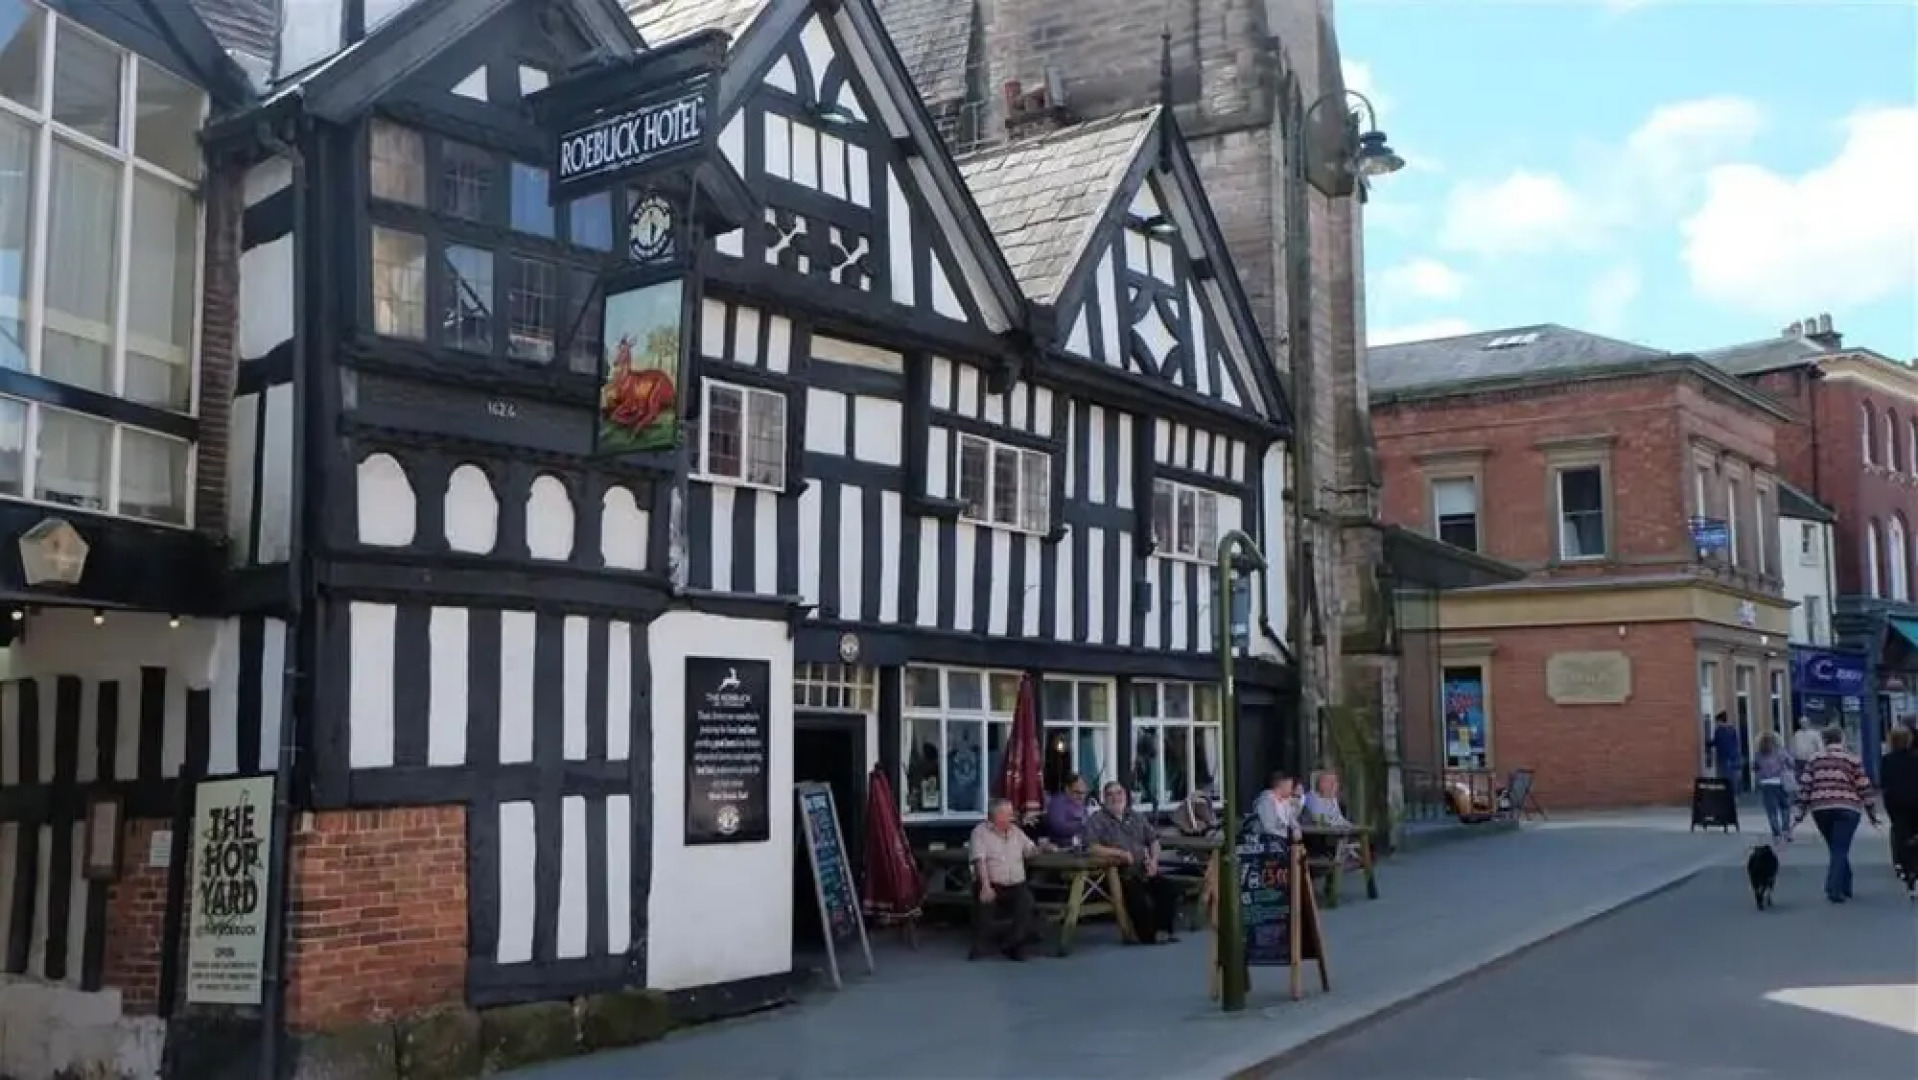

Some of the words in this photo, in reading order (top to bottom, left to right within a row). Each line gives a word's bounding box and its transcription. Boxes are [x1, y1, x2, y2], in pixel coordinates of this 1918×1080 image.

[561, 117, 641, 177] ROEBUCK
[643, 100, 701, 151] HOTEL
[209, 805, 255, 841] THE
[204, 842, 258, 878] HOP
[201, 879, 258, 916] YARD
